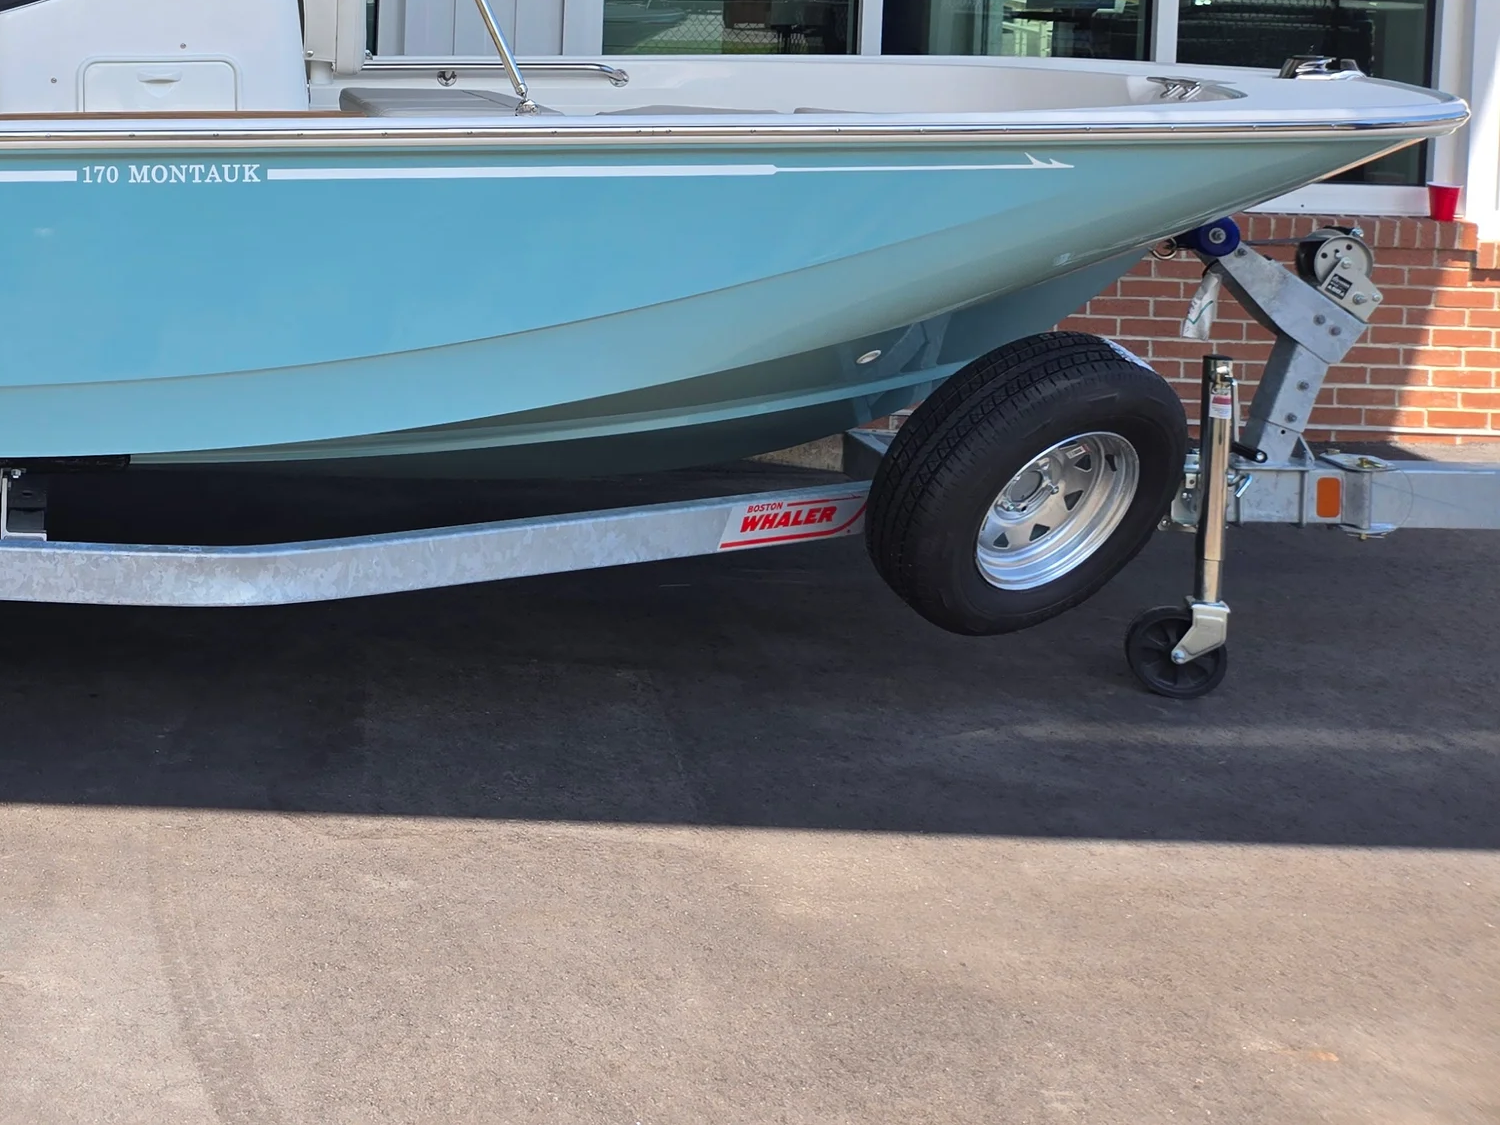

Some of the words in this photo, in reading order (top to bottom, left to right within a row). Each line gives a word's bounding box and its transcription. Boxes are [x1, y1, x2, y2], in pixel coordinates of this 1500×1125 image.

[82, 165, 119, 184] 170
[128, 164, 261, 183] MONTAUK
[747, 501, 784, 514] BOSTON
[739, 506, 838, 534] WHALER
